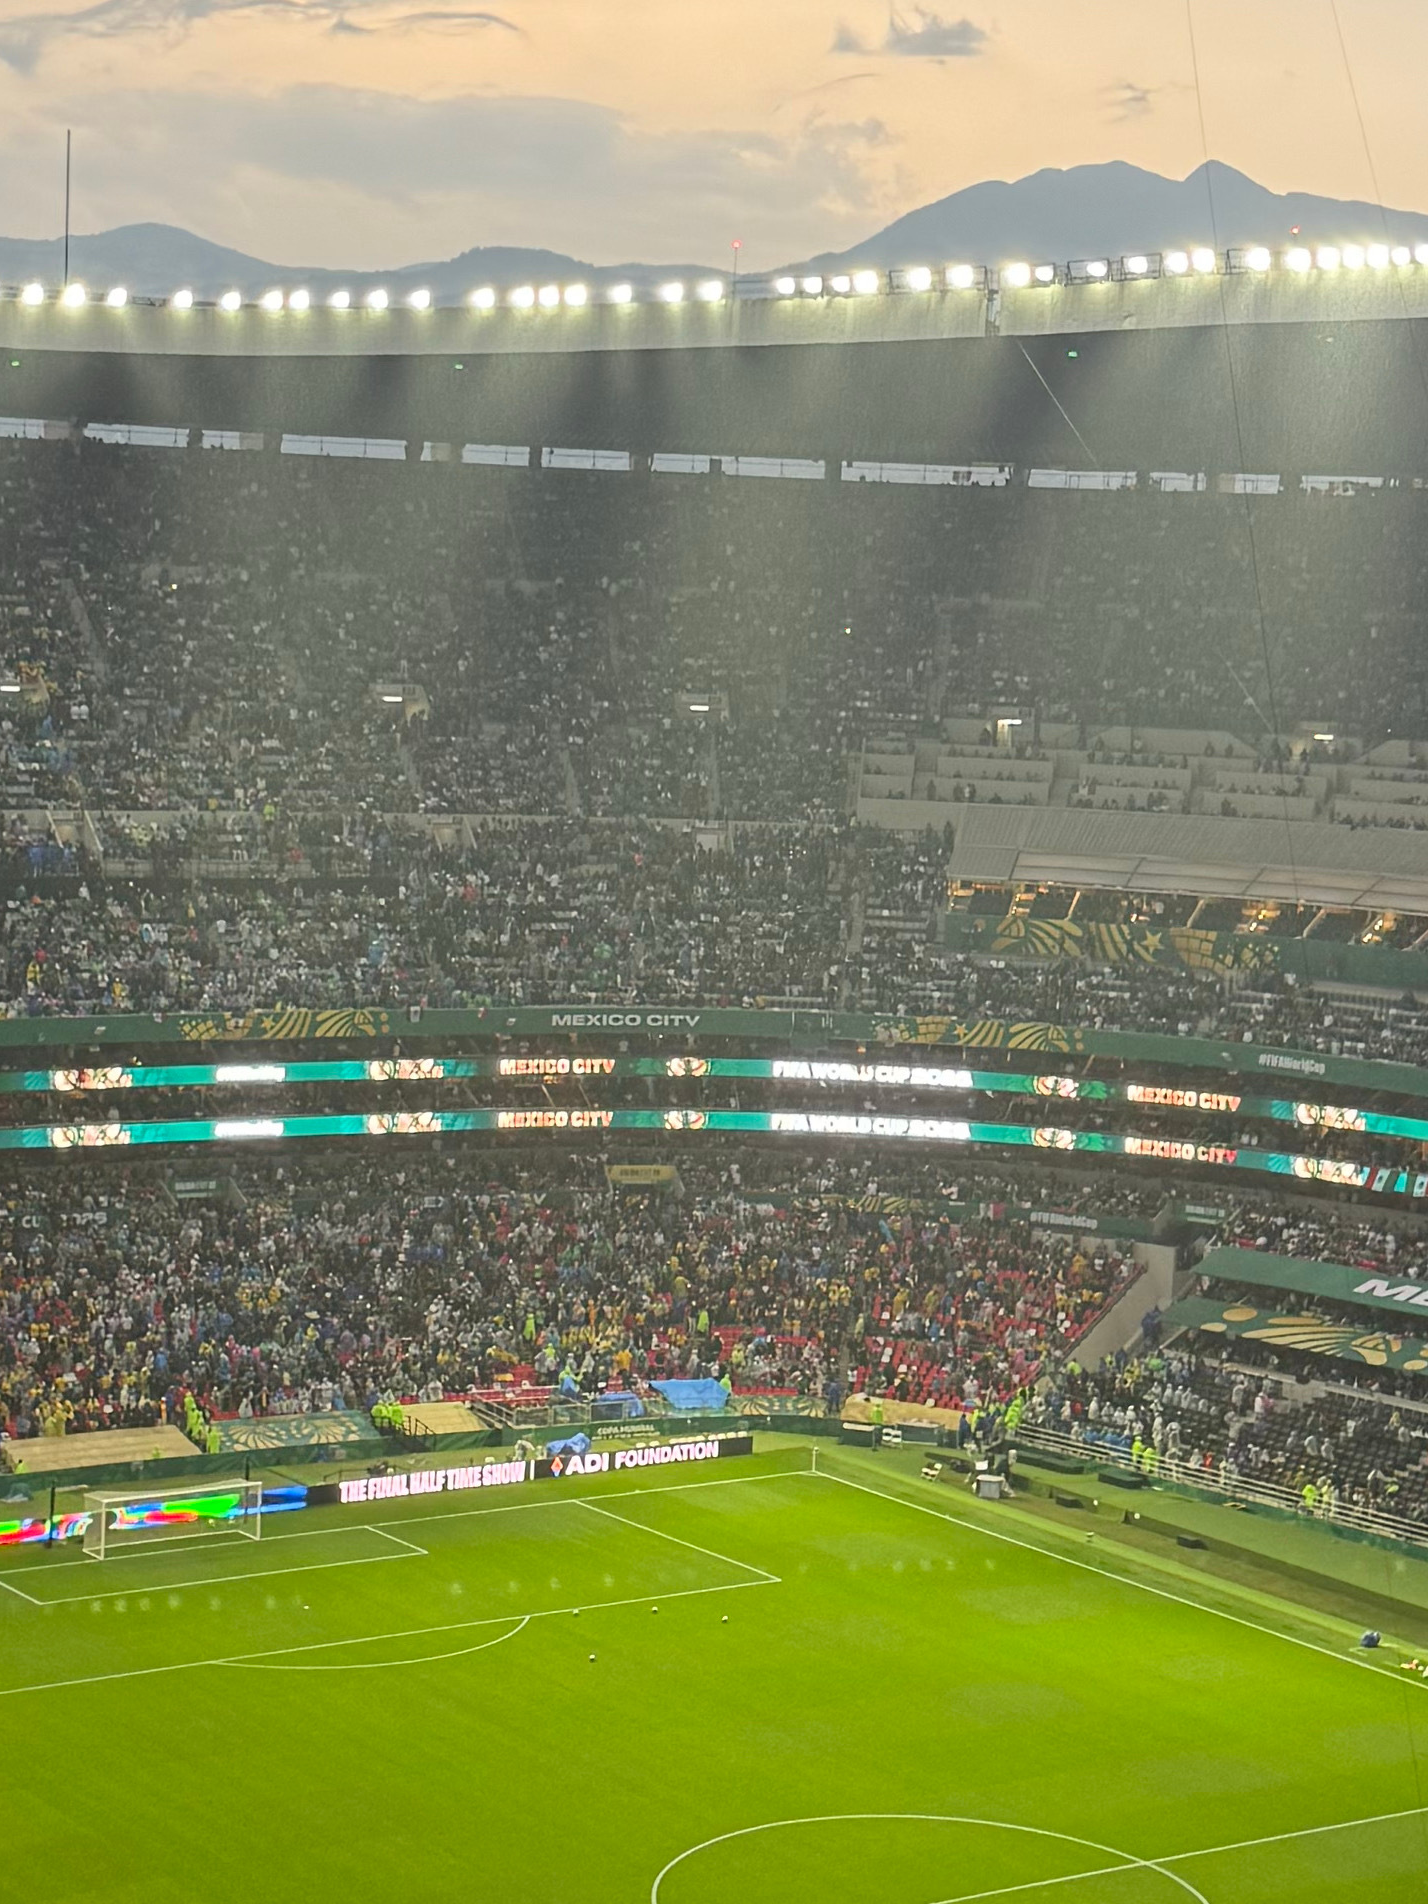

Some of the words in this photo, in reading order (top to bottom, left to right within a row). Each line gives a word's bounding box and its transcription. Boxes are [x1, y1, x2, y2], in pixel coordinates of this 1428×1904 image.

[551, 1013, 641, 1027] MEXICO
[646, 1013, 701, 1027] CITY
[499, 1058, 569, 1075] MEXICO
[571, 1057, 615, 1075] CITY
[1128, 1085, 1197, 1108] MEXICO
[1198, 1092, 1241, 1112] CITY
[497, 1110, 568, 1128] MEXICO
[570, 1109, 614, 1128] CITY
[1124, 1136, 1194, 1160] MEXICO
[1196, 1145, 1238, 1165] CITY
[339, 1479, 368, 1503] THE
[368, 1474, 409, 1500] FINAL
[482, 1460, 527, 1486] SHOW
[565, 1452, 610, 1476] ADI
[615, 1440, 720, 1470] FOUNDATION
